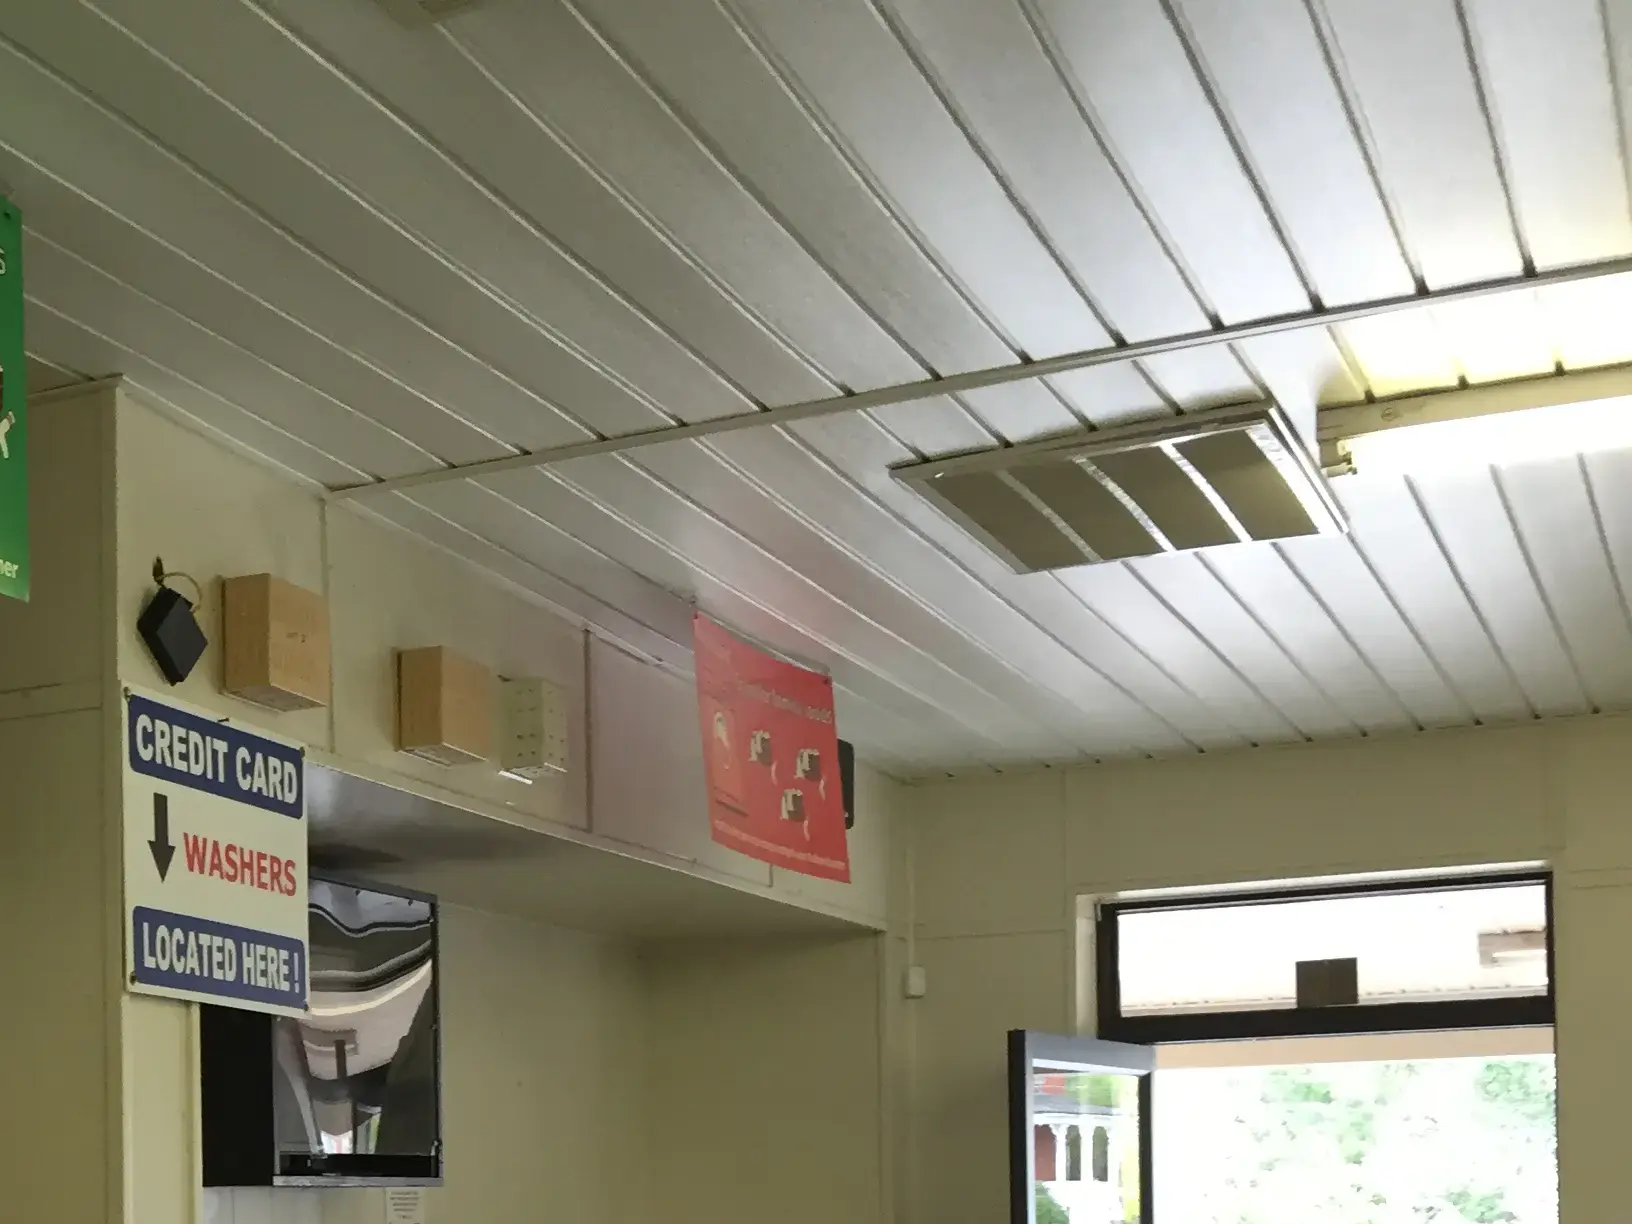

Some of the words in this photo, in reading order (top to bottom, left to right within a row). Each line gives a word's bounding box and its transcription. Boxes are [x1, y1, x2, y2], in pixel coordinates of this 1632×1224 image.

[135, 713, 228, 784] CREDIT
[235, 746, 298, 805] CARD
[183, 832, 297, 897] WASHERS
[143, 921, 237, 983] LOCATED
